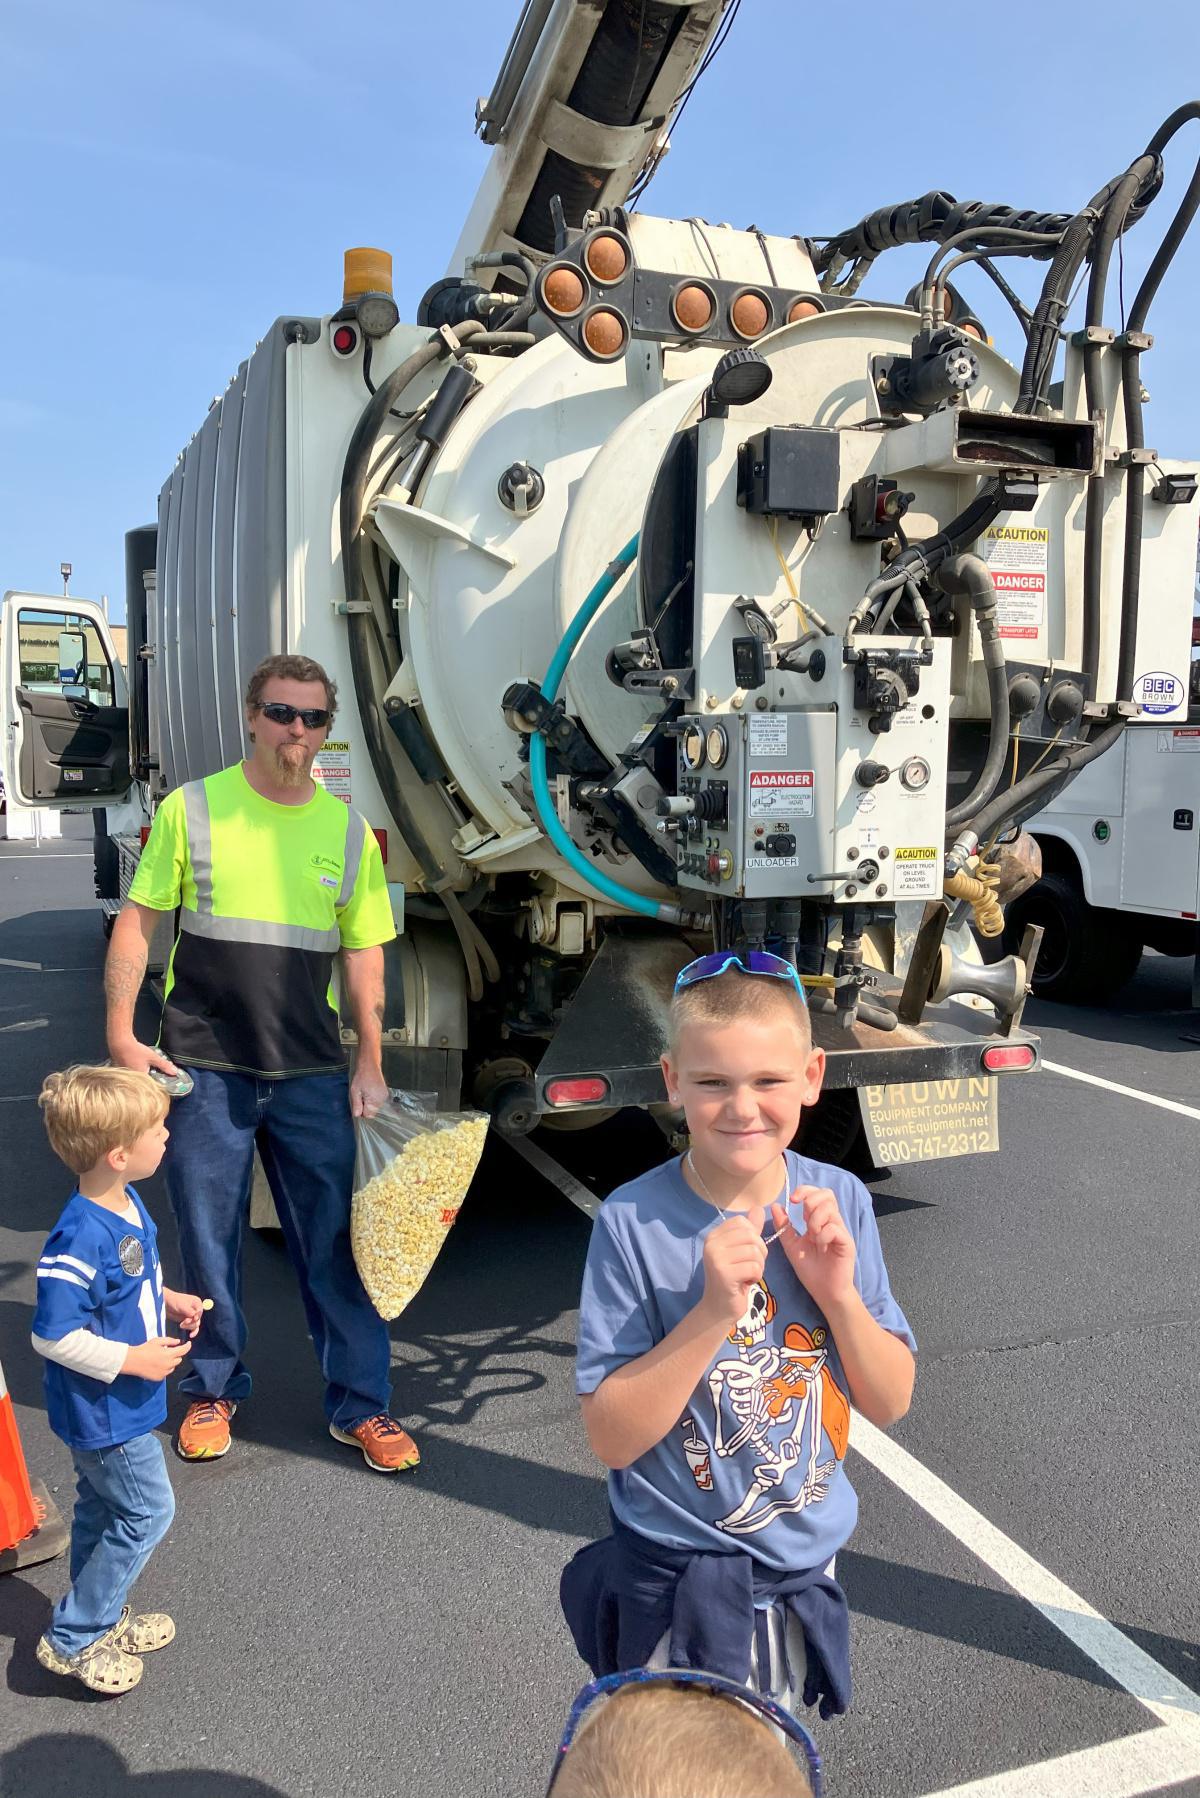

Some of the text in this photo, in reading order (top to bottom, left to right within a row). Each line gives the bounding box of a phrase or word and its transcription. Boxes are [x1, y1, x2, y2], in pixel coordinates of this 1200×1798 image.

[996, 528, 1046, 541] CAUTION
[996, 575, 1043, 589] DANGER
[1143, 679, 1175, 693] BEC
[321, 743, 349, 751] AUTION
[761, 775, 810, 785] DANGER
[902, 849, 936, 859] CAUTION
[747, 858, 797, 868] UNLOADER
[870, 1100, 989, 1123] EQUIPMENT COMPANY
[873, 1114, 989, 1138] BrownEquipment.net
[878, 1131, 990, 1163] 800-747-2312
